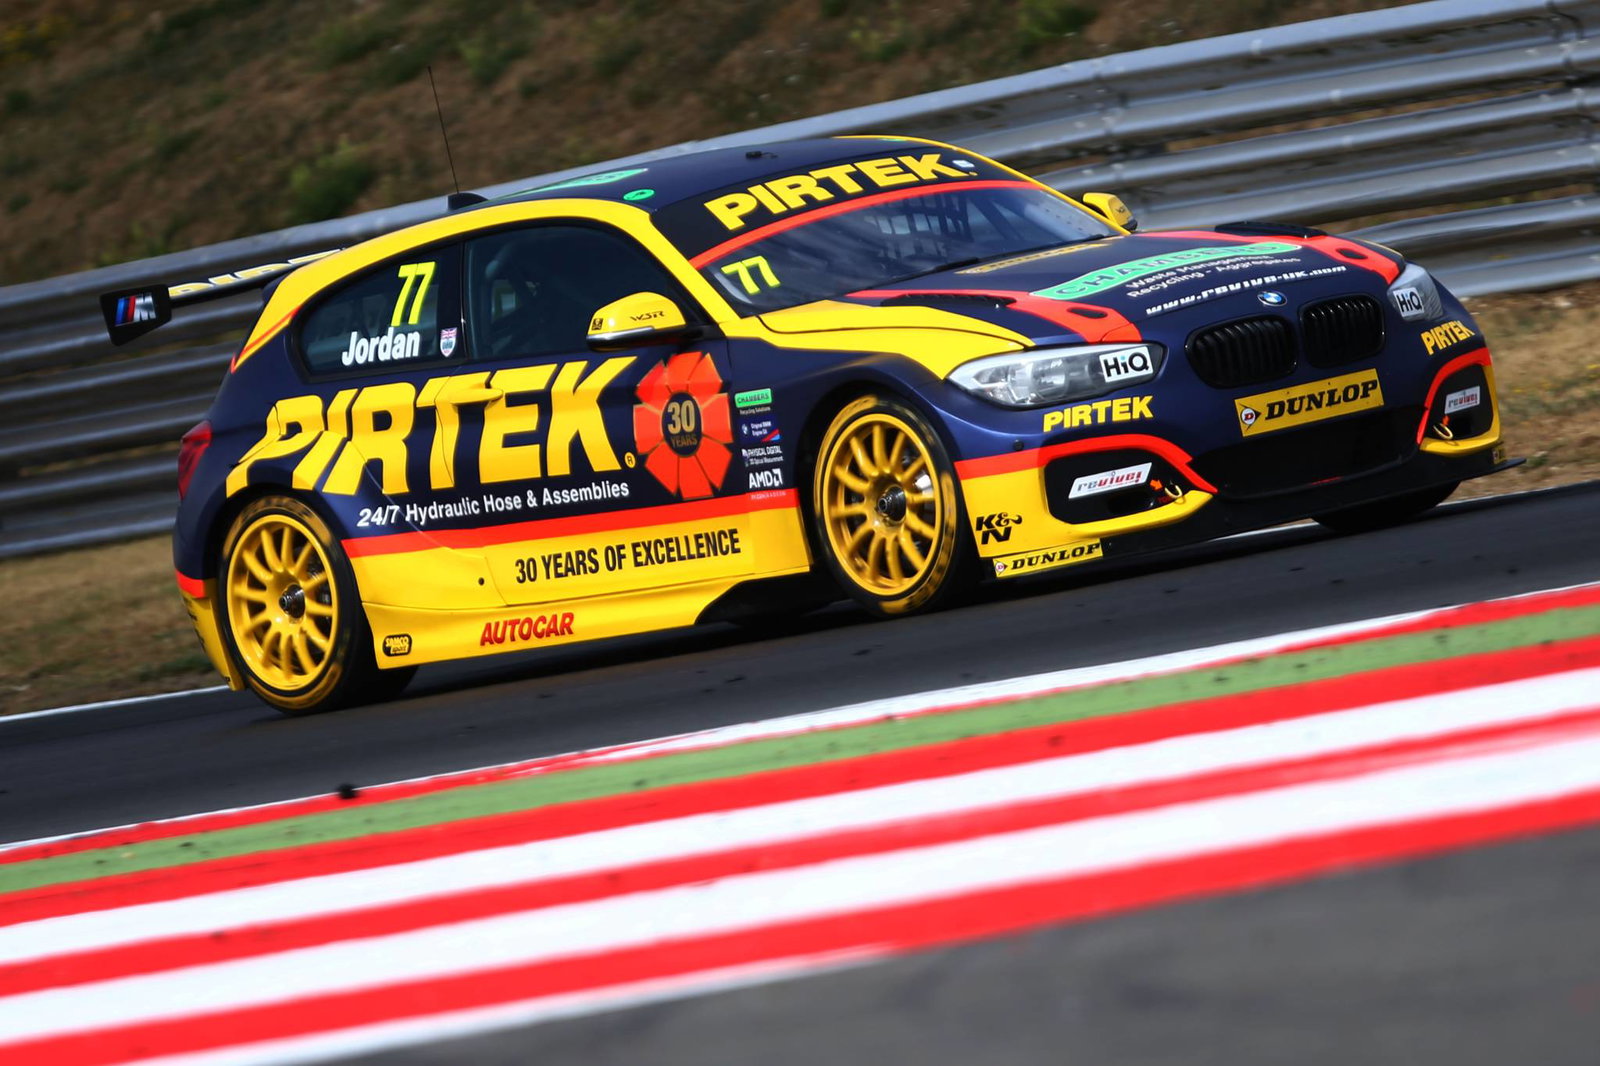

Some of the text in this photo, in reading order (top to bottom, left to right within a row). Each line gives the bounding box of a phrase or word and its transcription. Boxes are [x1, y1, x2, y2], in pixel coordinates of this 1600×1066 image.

[704, 153, 970, 231] PIRTEK
[721, 255, 781, 295] 77
[1125, 254, 1274, 289] Waste Management
[1126, 271, 1205, 298] Recycling
[390, 261, 435, 327] 77
[1396, 291, 1422, 313] HiQ
[342, 327, 420, 366] Jordan
[1421, 320, 1475, 356] PIRTEK
[1103, 352, 1149, 377] HiQ
[667, 400, 695, 434] 30
[1043, 395, 1154, 433] PIRTEK
[1265, 379, 1378, 421] DUNLOP
[226, 356, 638, 498] PIRTEK
[671, 434, 698, 448] YEARS
[749, 470, 774, 489] AMD
[357, 505, 399, 528] 24/7
[406, 498, 480, 526] Hydraulic
[484, 493, 522, 512] Hose
[526, 489, 538, 507] &
[542, 480, 630, 506] Assemblies
[515, 528, 741, 584] 30 YEARS OF EXCELLENCE
[1011, 543, 1100, 570] DUNLOP
[480, 612, 575, 646] AUTOCAR
